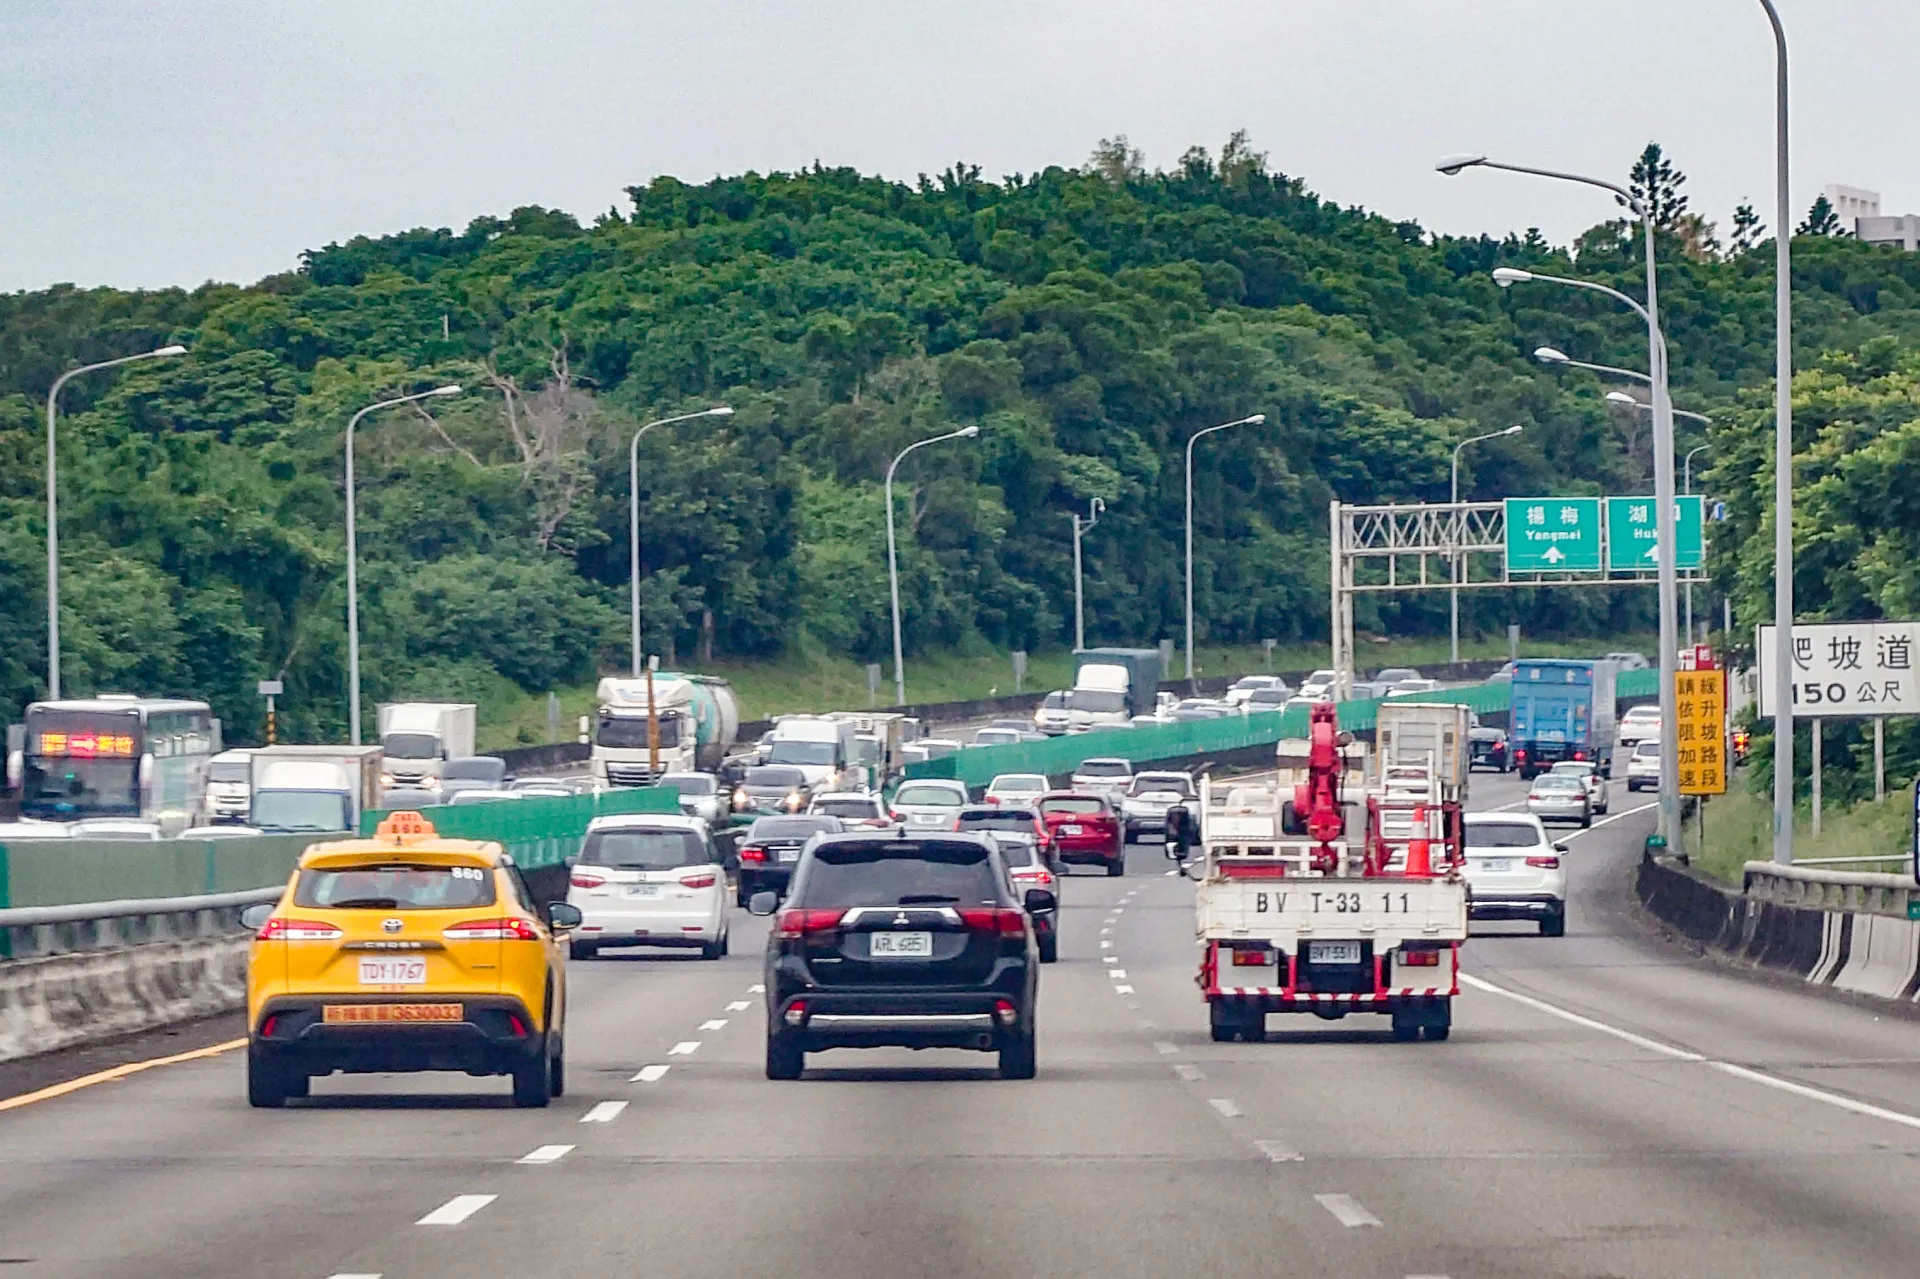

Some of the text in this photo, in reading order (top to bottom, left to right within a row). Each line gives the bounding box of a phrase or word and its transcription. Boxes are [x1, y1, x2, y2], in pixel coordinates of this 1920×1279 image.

[1526, 506, 1579, 525] 楊梅
[1525, 529, 1582, 542] Yangmei
[1633, 528, 1659, 539] Huk
[1792, 680, 1901, 704] 150 公尺
[1678, 678, 1697, 787] 請依限加速
[1700, 677, 1718, 787] 緩升坡路段
[451, 867, 484, 881] 860
[361, 963, 425, 979] TDY-1767
